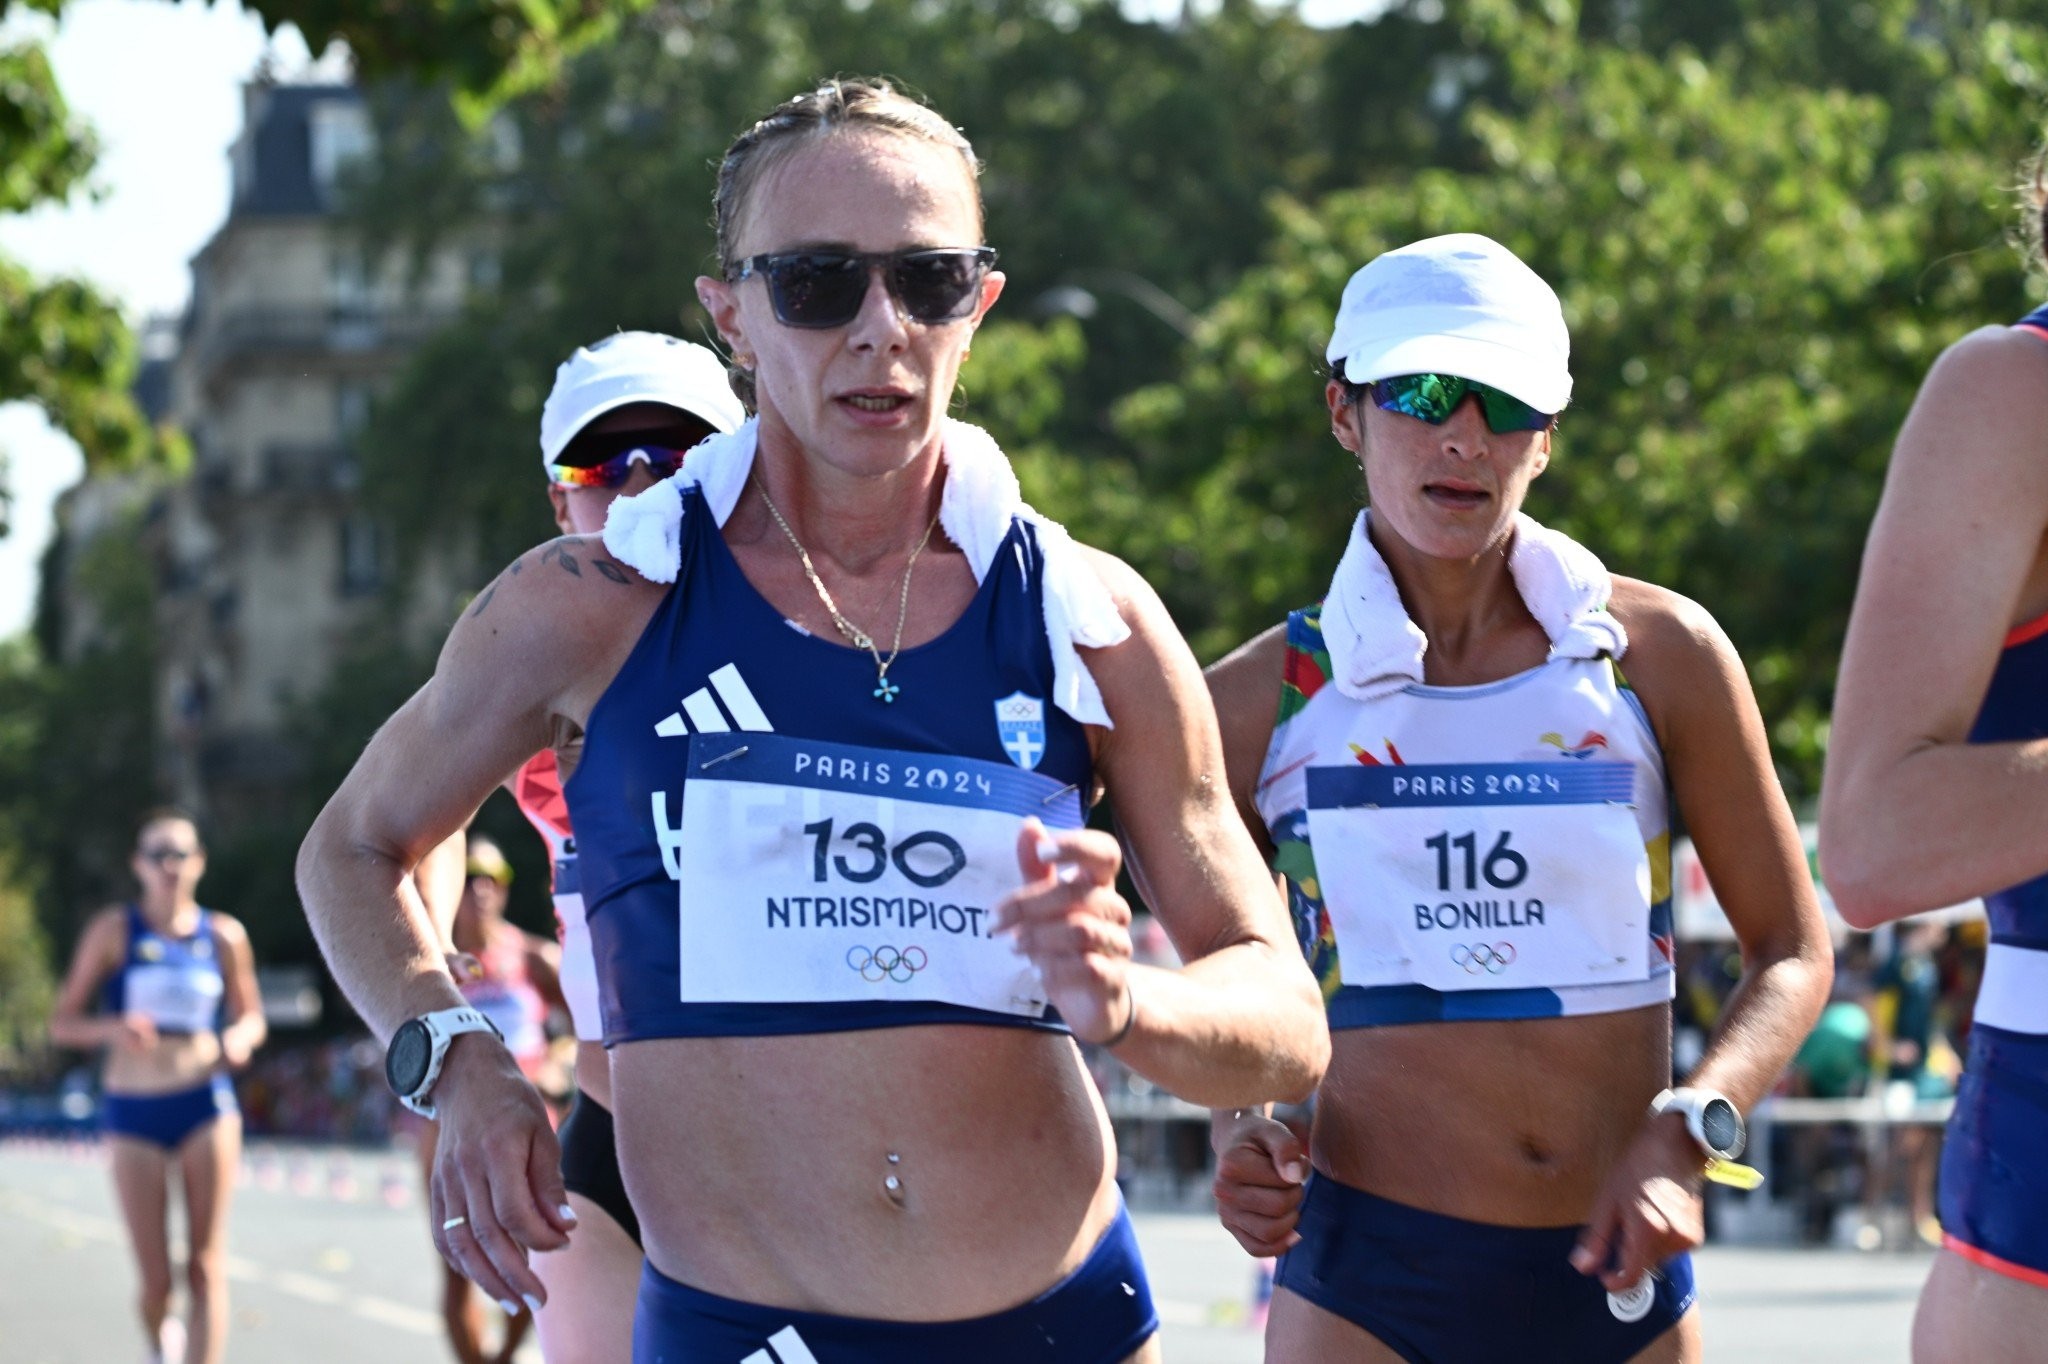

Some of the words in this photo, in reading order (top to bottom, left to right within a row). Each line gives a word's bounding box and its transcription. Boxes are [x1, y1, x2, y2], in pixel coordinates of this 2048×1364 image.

[795, 752, 890, 784] PARIS
[904, 767, 991, 796] 2024
[1393, 775, 1476, 796] PARIS
[1485, 773, 1561, 794] 2024
[803, 817, 967, 888] 130
[1425, 830, 1529, 892] 116
[1414, 898, 1545, 930] BONILLA
